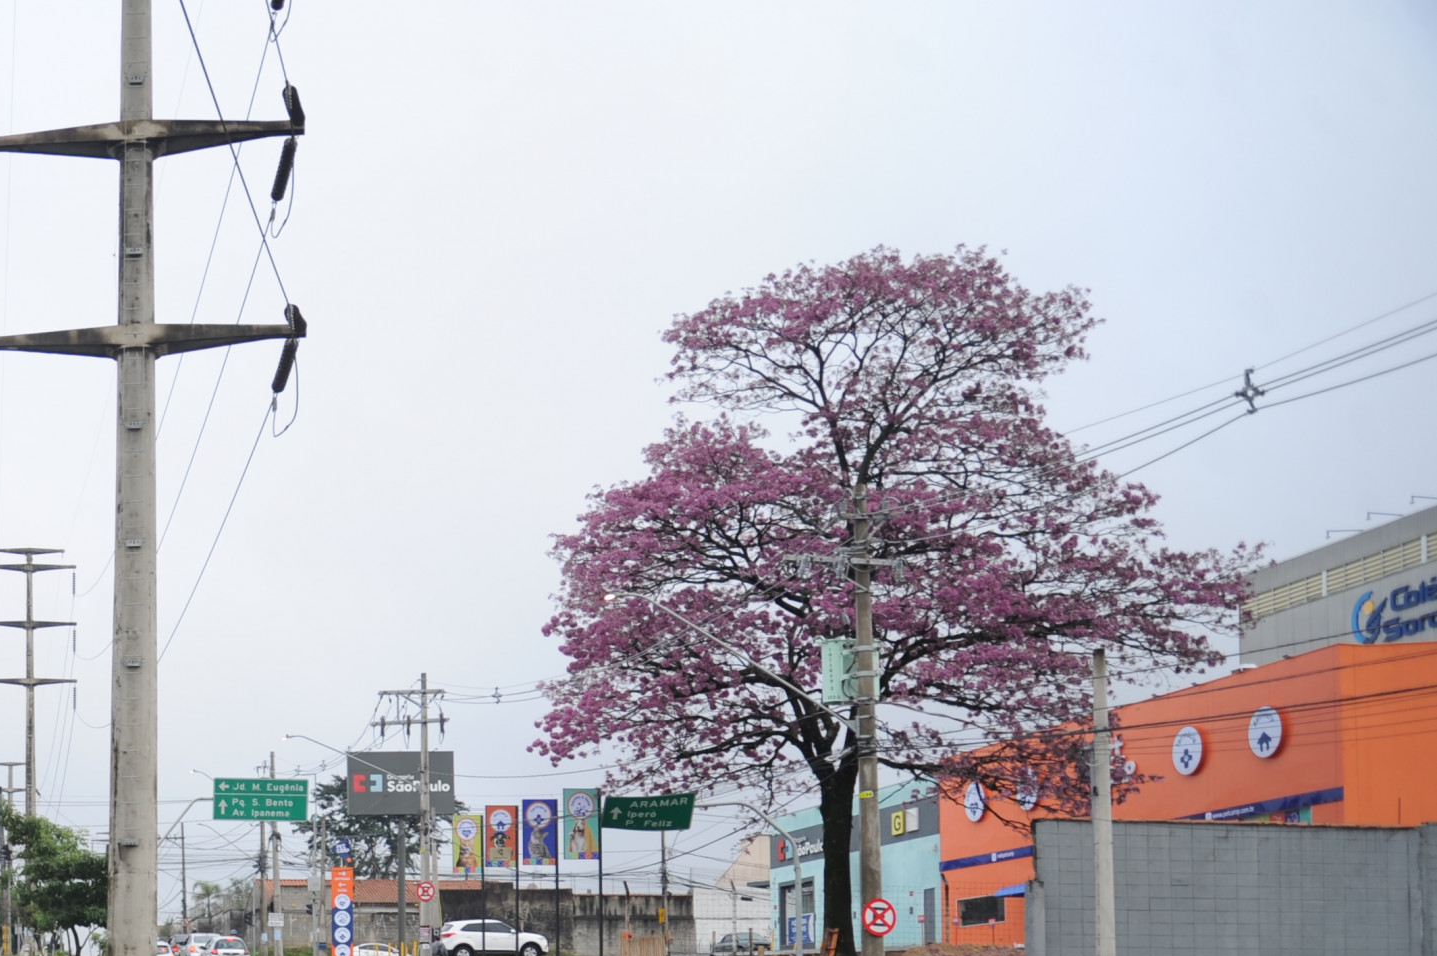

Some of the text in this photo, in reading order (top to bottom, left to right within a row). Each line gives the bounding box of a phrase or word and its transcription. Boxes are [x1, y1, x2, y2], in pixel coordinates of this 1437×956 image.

[267, 783, 304, 794] Eugênia
[387, 779, 450, 793] SãoPulo
[266, 799, 293, 807] Bento
[630, 797, 688, 808] ARAMAR
[251, 809, 290, 818] Ipanema
[644, 820, 673, 828] Feliz
[893, 815, 901, 832] G
